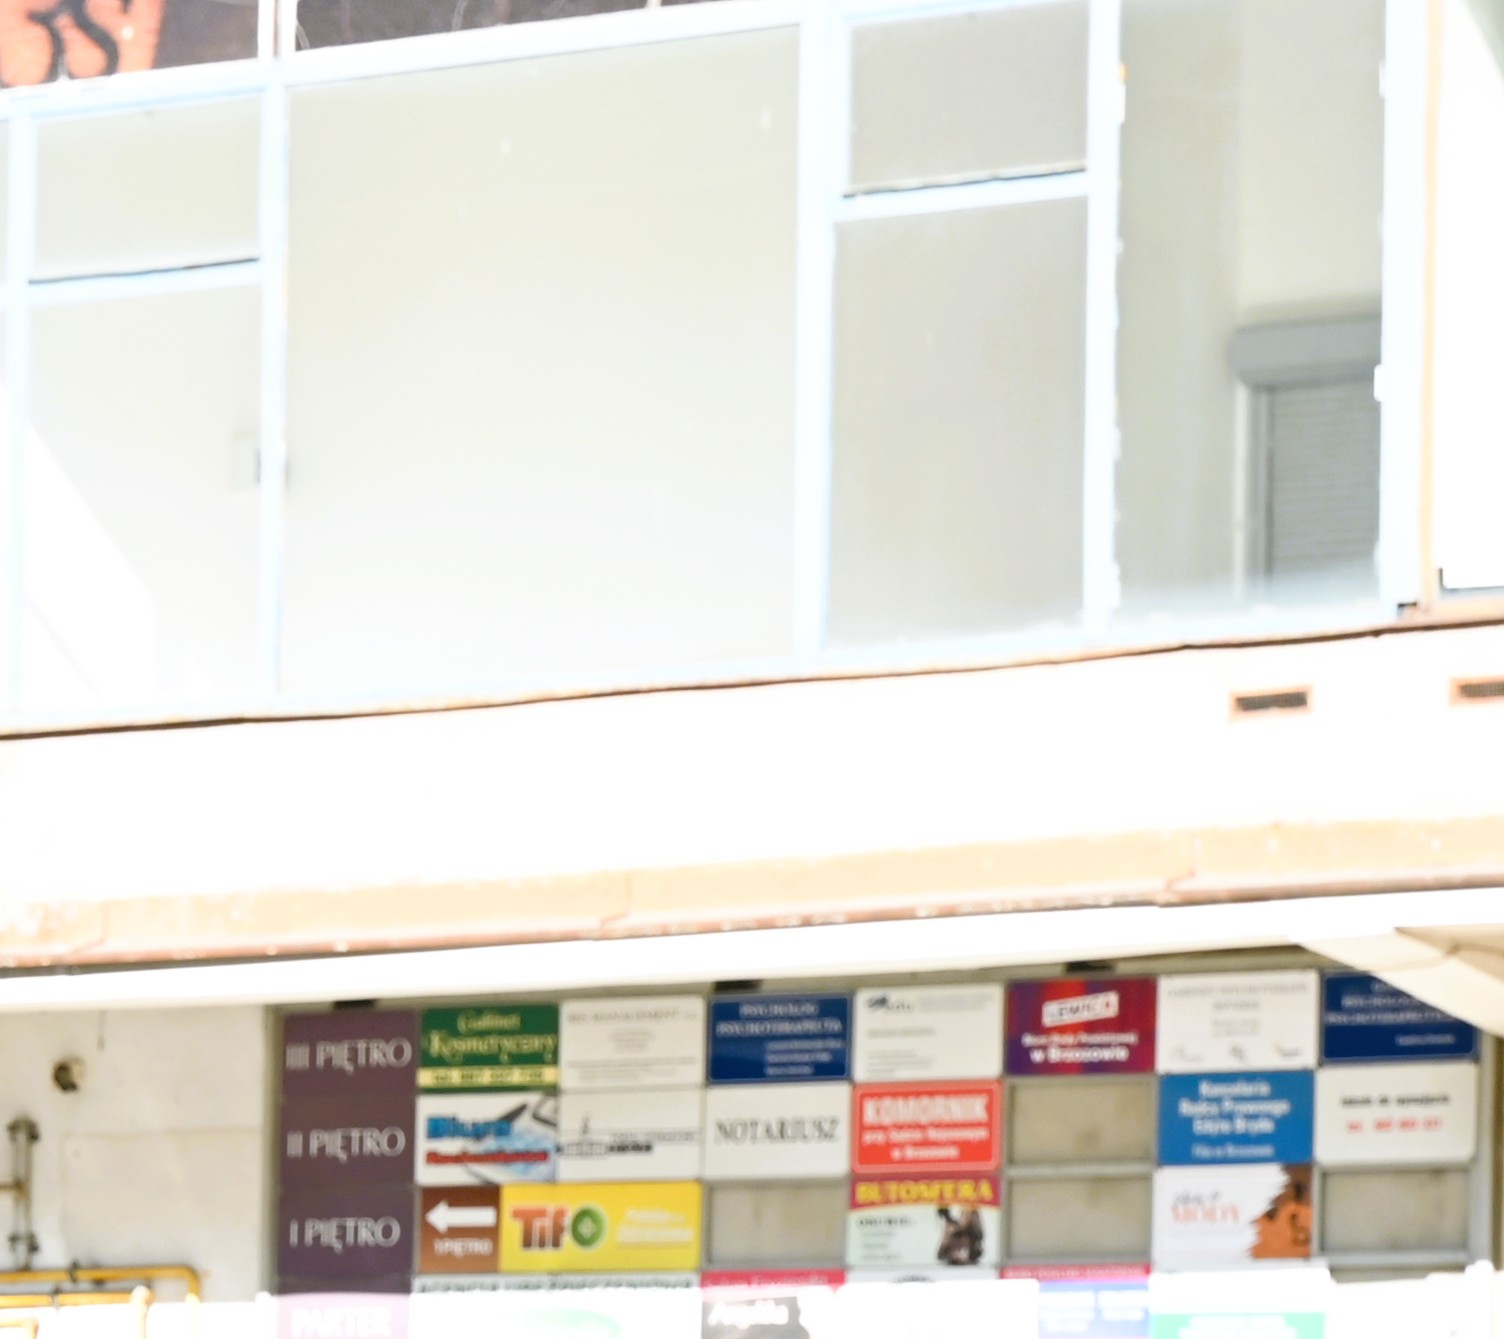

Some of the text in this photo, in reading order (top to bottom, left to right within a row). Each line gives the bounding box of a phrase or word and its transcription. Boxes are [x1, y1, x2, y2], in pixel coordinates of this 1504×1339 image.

[286, 1037, 412, 1075] III PIĘTRO
[863, 1094, 988, 1125] KOMORNIK
[287, 1131, 302, 1158] II
[309, 1126, 406, 1163] PIĘTRO
[714, 1117, 839, 1145] NOTARIUSZ
[305, 1216, 400, 1254] PIĘTRO
[291, 1306, 392, 1338] PARTER
